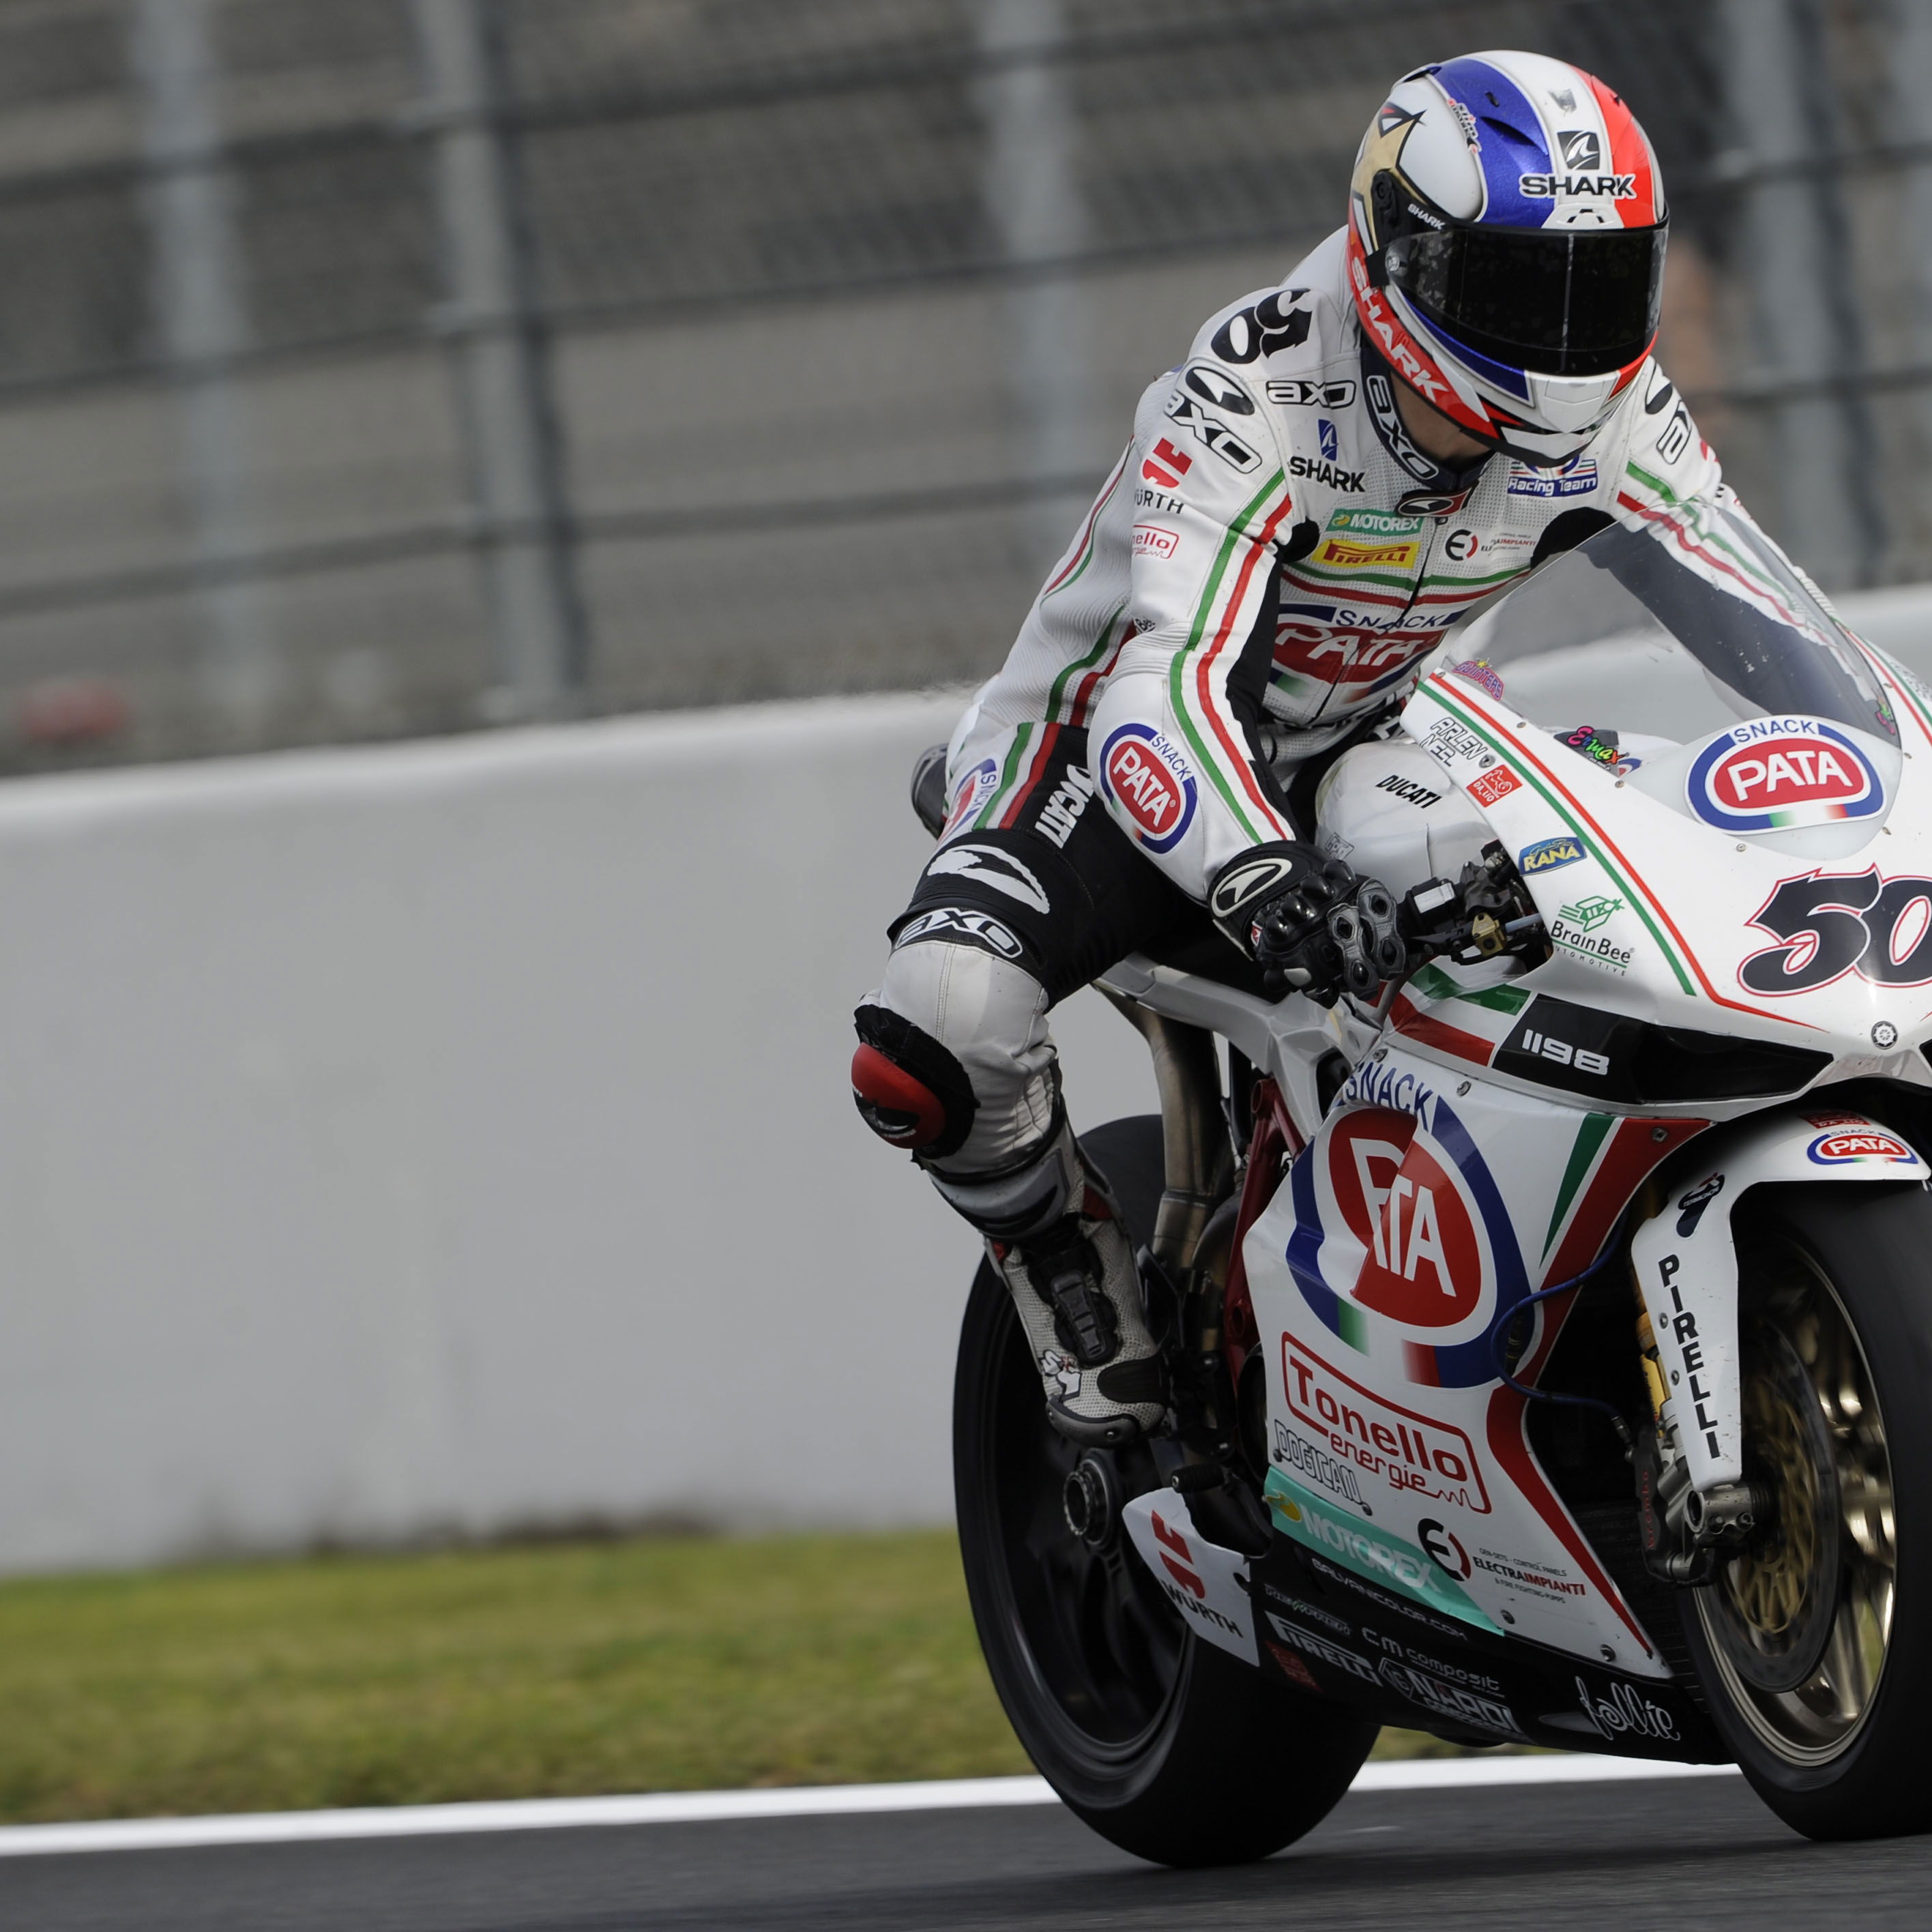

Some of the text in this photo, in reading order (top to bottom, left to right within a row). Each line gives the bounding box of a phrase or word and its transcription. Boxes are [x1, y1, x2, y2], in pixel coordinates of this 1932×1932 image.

[1522, 175, 1635, 196] SHARK
[1407, 204, 1446, 230] SHARK
[1351, 257, 1445, 402] SHARK
[1290, 456, 1365, 492] SHARK
[1508, 478, 1596, 495] Racing Team
[1350, 513, 1420, 531] MOTOREX
[1323, 543, 1410, 564] PIRELLI
[1336, 610, 1445, 630] SNACK
[1275, 628, 1426, 667] PATA
[1430, 716, 1489, 761] ARLEN
[1733, 719, 1816, 742] SNACK
[1152, 733, 1192, 780] SNACK
[1727, 750, 1853, 802] PATA
[1034, 763, 1094, 849] DUCATI
[1113, 746, 1171, 828] PATA
[1375, 775, 1442, 809] DUCATI
[1523, 845, 1580, 872] RANA
[1737, 863, 1932, 998] 50
[1555, 945, 1626, 978] UTOMOTIVE
[1522, 1029, 1609, 1076] 1198
[1346, 1062, 1433, 1132] SNACK
[1828, 1137, 1901, 1154] PATA
[1658, 1254, 1721, 1459] PIRELLI
[1289, 1355, 1467, 1482] Tonello
[1330, 1432, 1426, 1490] energie
[1298, 1503, 1443, 1592] MOTOREX
[1472, 1556, 1586, 1595] ELECTRAIMPIANTI
[1264, 1610, 1384, 1686] PIRELLI
[1404, 1667, 1523, 1734] NARDI
